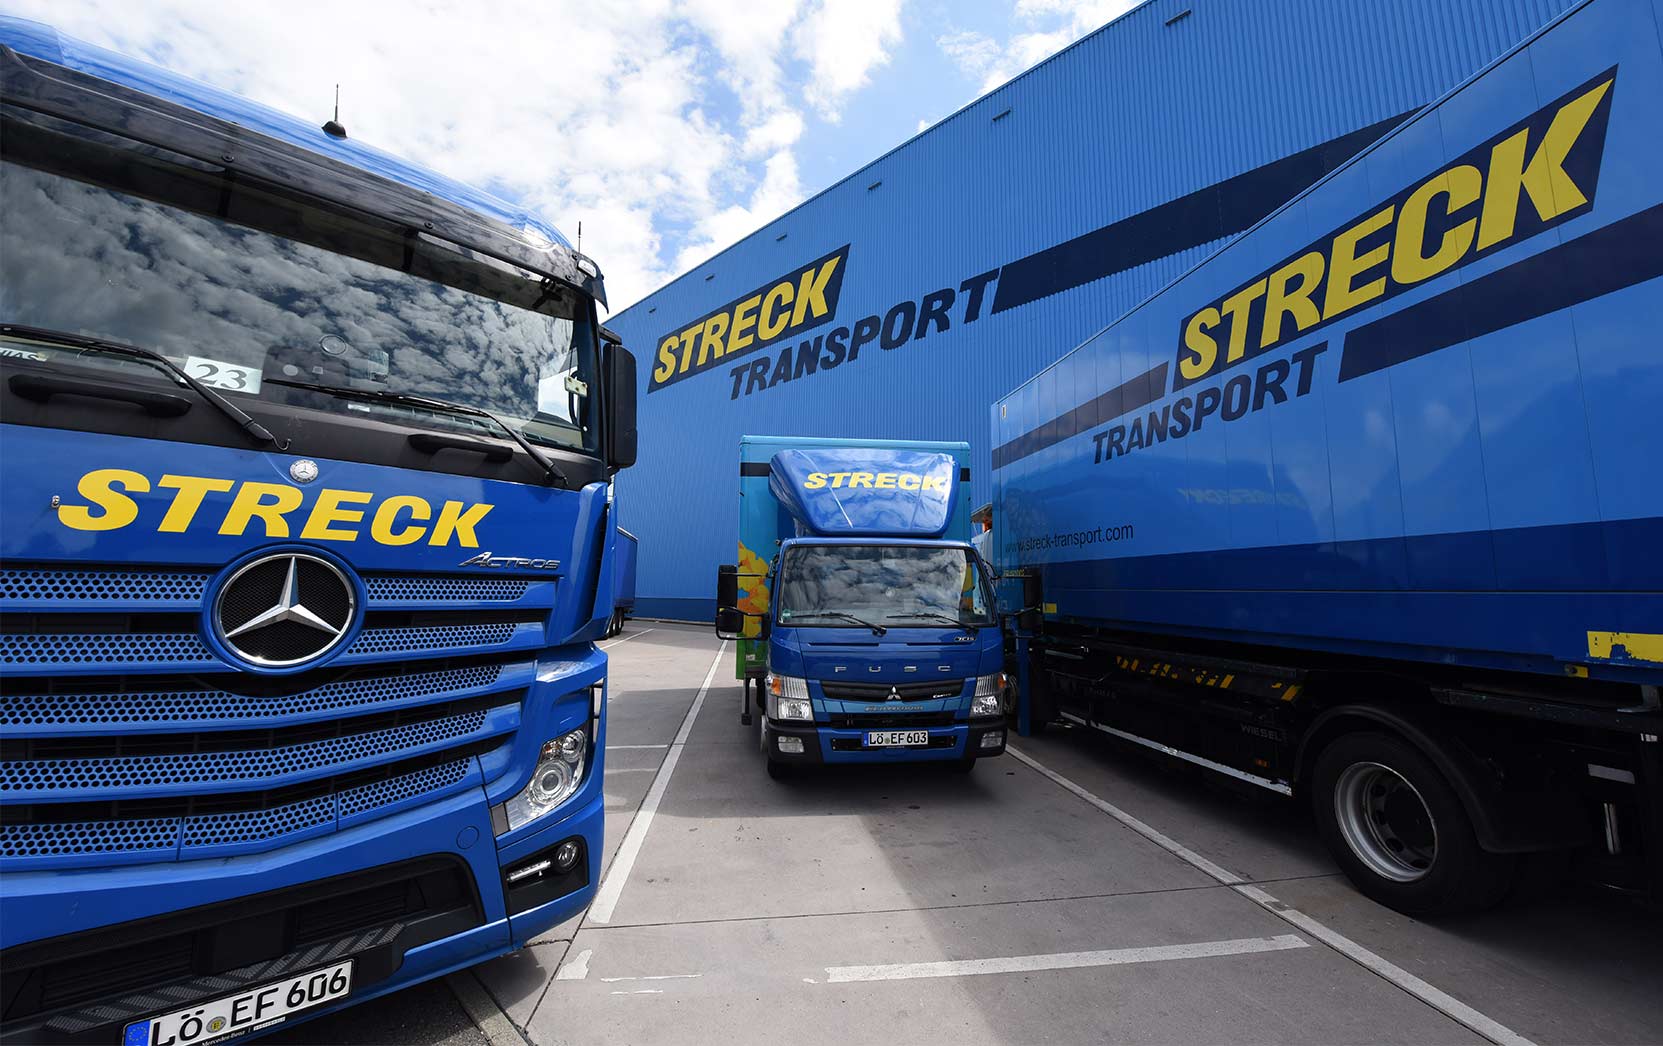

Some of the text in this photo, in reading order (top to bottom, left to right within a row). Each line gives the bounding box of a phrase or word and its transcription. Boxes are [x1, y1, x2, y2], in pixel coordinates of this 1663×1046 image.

[1179, 78, 1614, 380] STRECK
[653, 256, 841, 384] STRECK
[729, 267, 1001, 400] TRANSPORT
[195, 363, 248, 389] 23
[1092, 340, 1329, 465] TRANSPORT
[58, 469, 494, 548] STRECK
[803, 472, 948, 491] STRECK
[1005, 524, 1134, 553] www.streck-transport.com
[869, 731, 927, 745] LÖ EF 603
[151, 967, 348, 1046] LÖ EF 606
